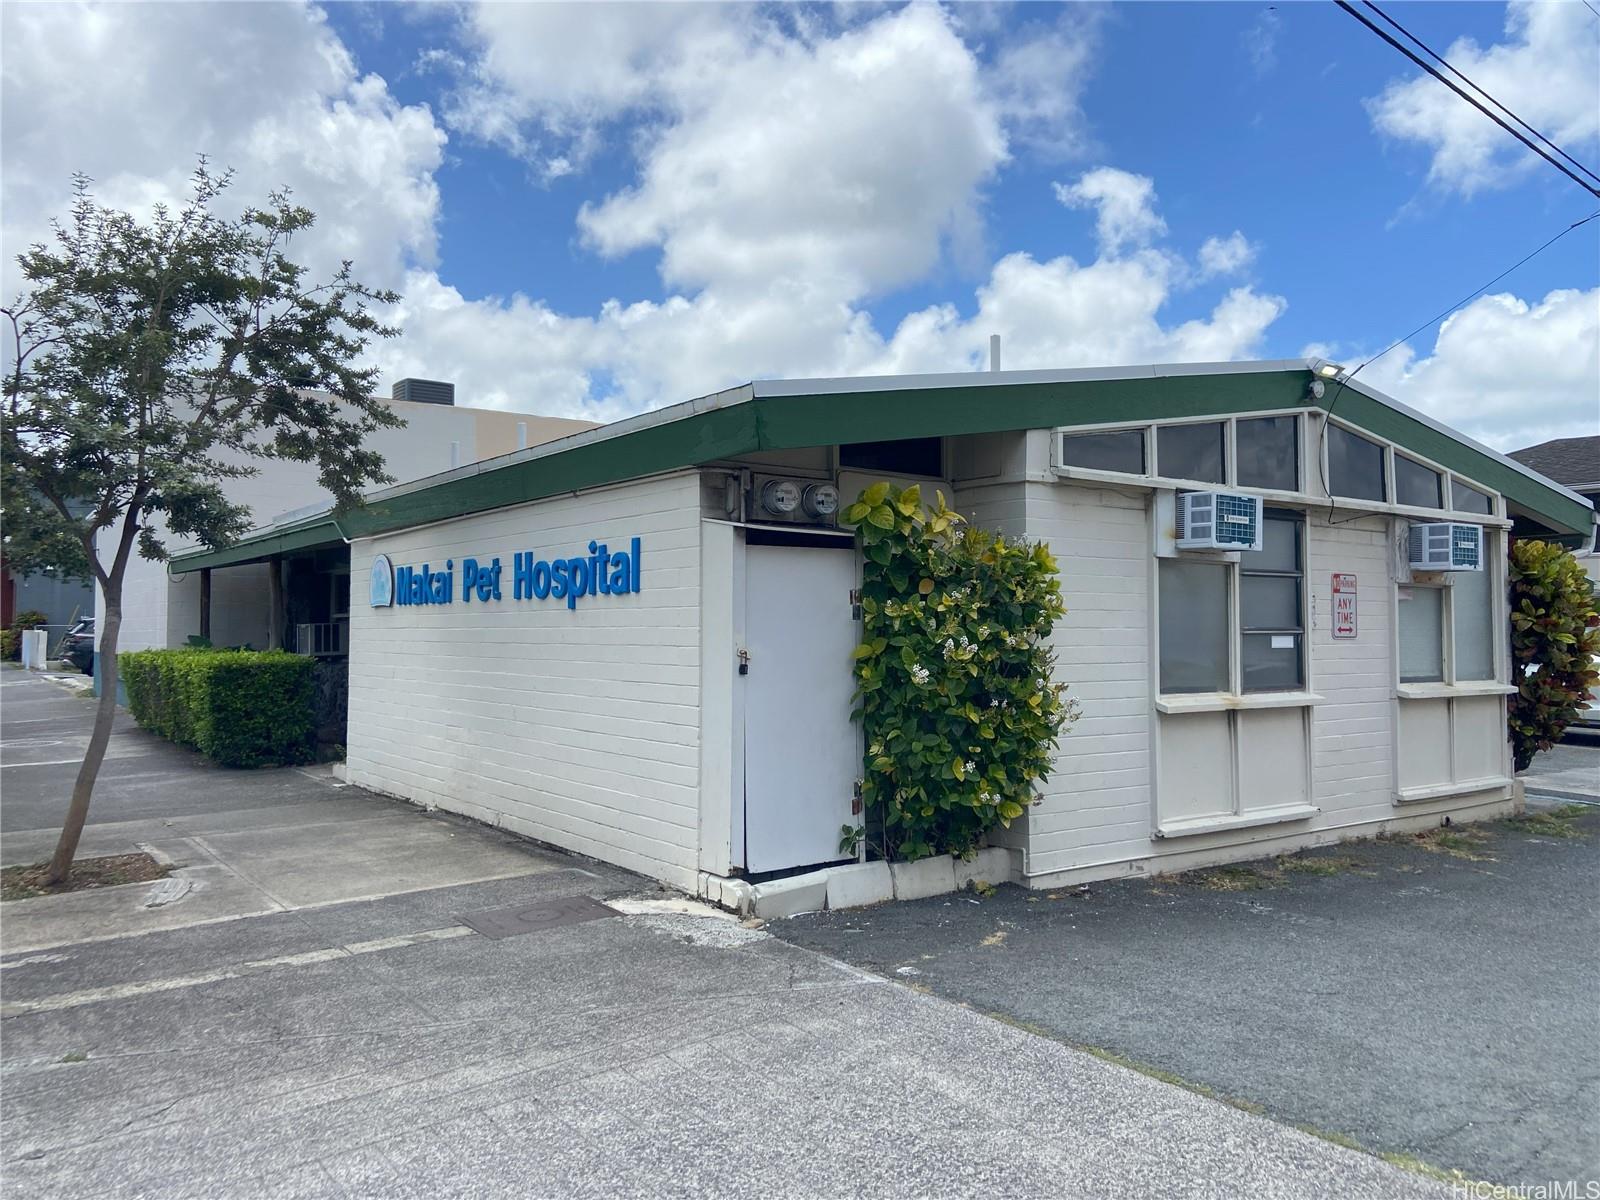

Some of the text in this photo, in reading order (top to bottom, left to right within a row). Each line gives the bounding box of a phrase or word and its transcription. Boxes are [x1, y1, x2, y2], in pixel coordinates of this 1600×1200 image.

[396, 536, 641, 610] Makai Pet Hospital
[1337, 598, 1352, 610] ANY
[1337, 612, 1353, 624] TIME
